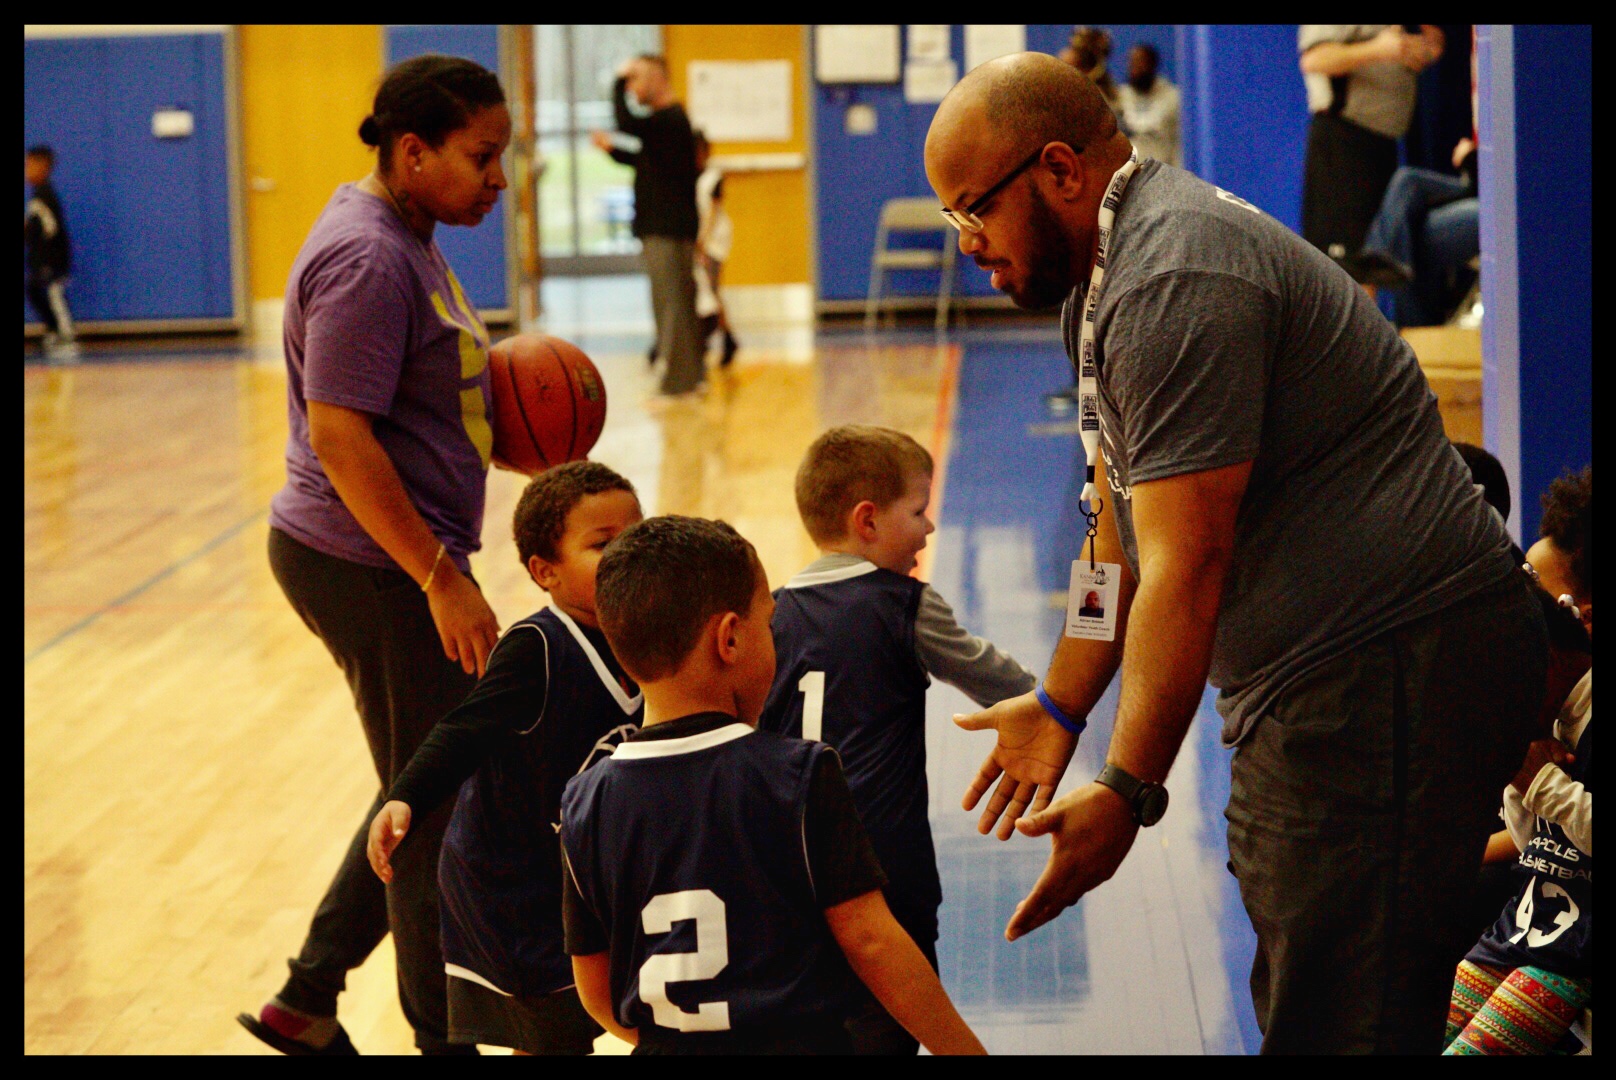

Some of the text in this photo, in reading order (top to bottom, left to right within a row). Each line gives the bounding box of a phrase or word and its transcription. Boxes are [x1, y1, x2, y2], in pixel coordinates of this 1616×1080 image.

[798, 671, 826, 742] 1
[1508, 875, 1580, 948] 43
[638, 889, 731, 1033] 2
